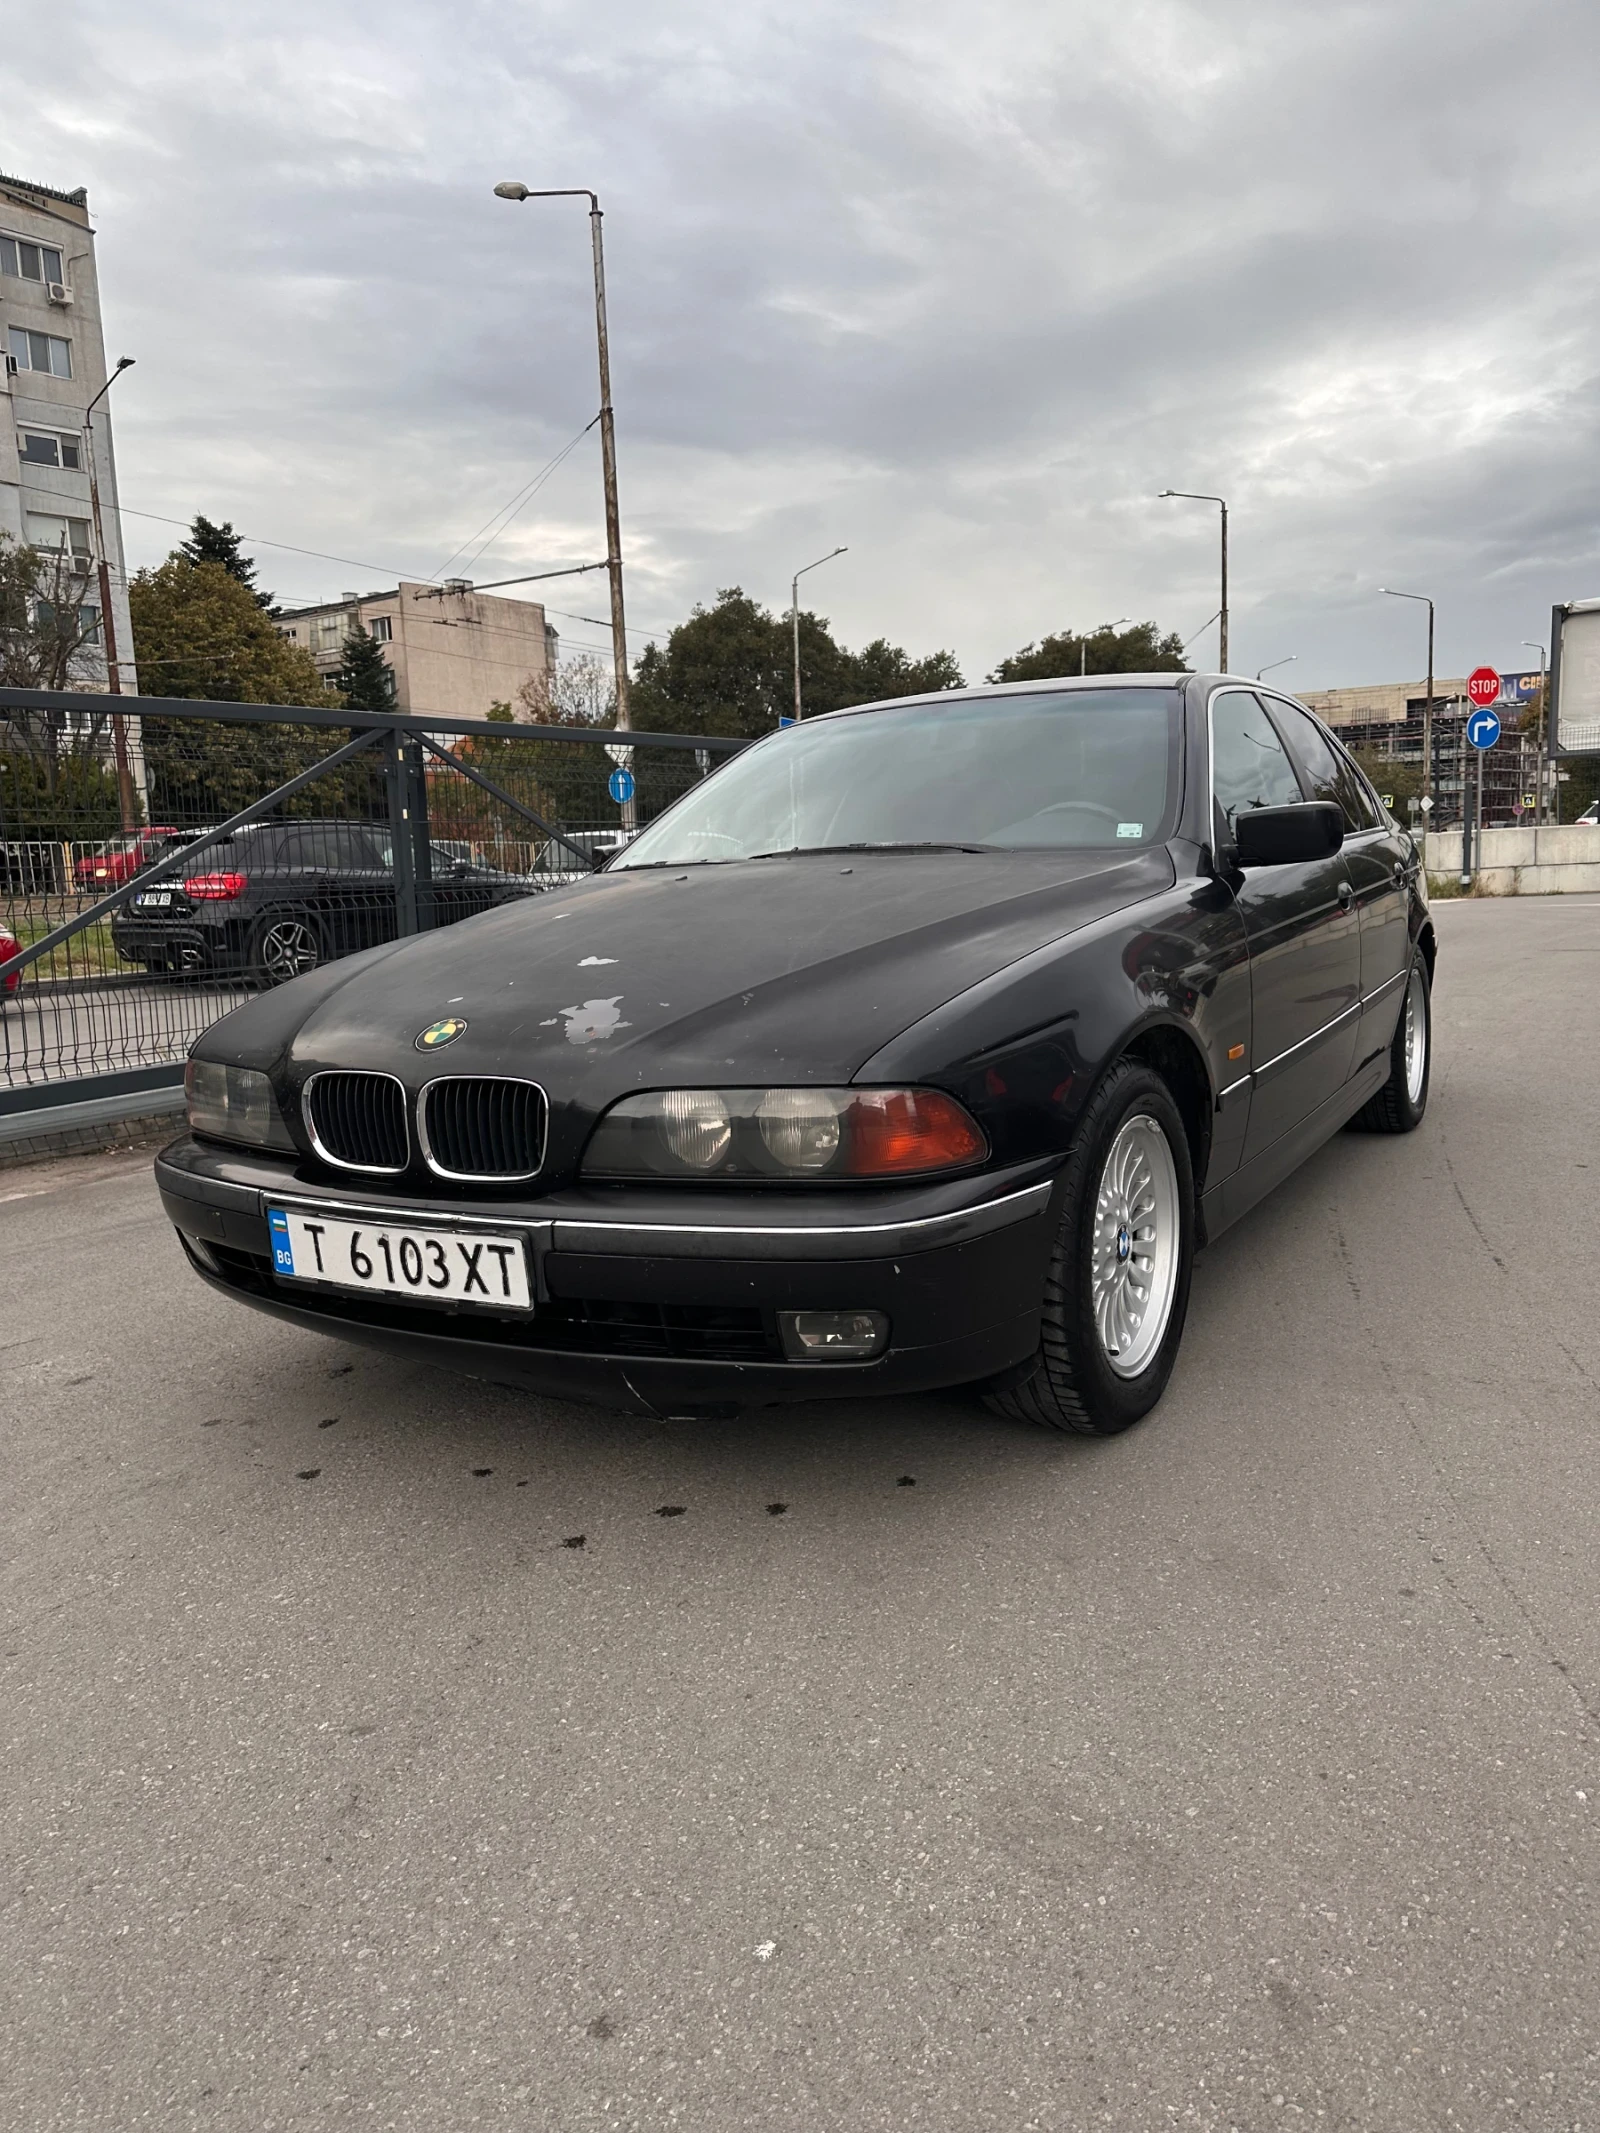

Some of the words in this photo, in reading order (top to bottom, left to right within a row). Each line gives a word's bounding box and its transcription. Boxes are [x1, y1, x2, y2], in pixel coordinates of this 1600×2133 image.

[1471, 679, 1498, 694] STOP
[303, 1223, 325, 1273] T
[276, 1250, 292, 1265] BG
